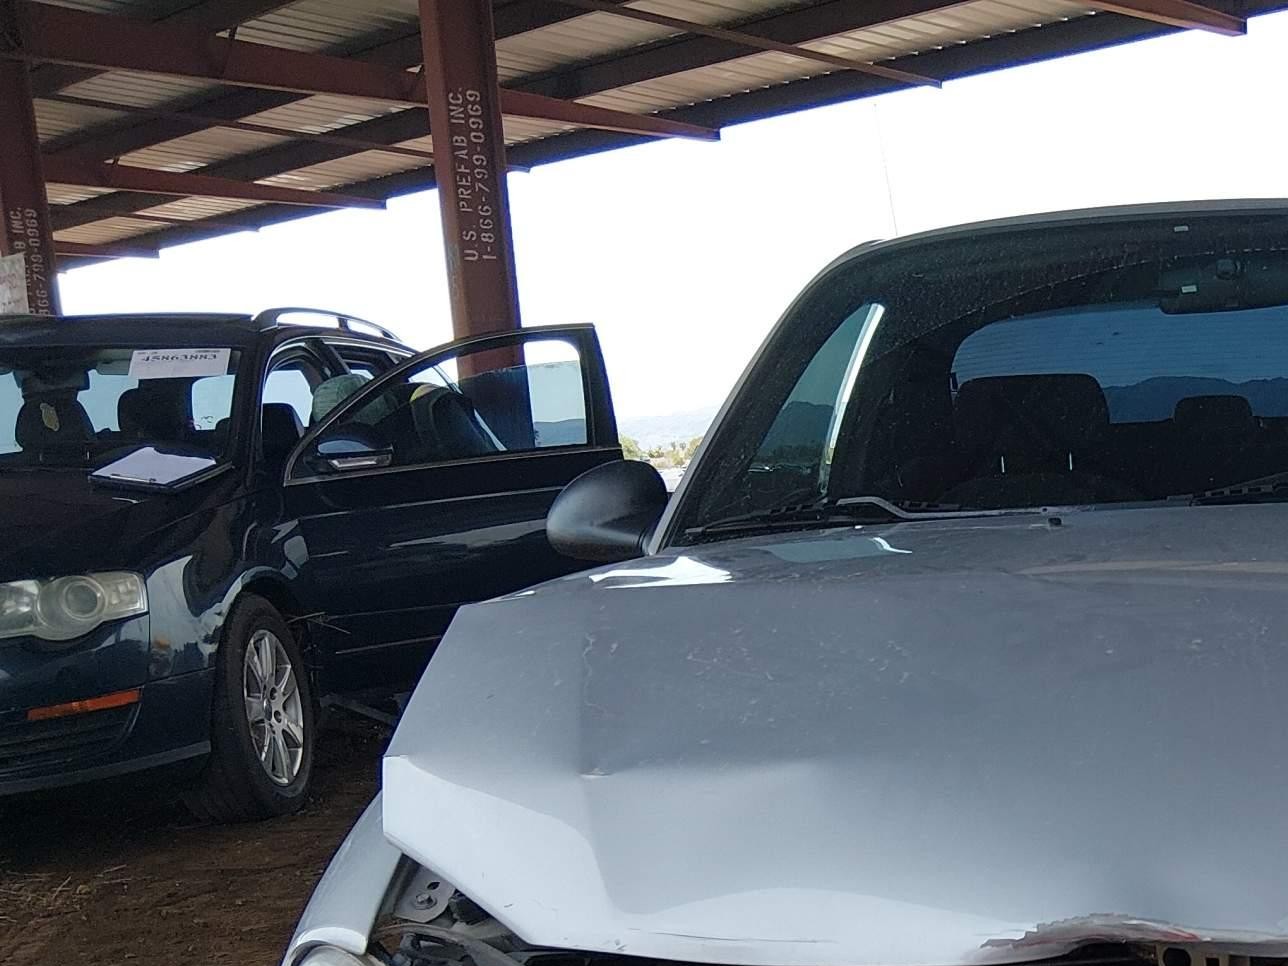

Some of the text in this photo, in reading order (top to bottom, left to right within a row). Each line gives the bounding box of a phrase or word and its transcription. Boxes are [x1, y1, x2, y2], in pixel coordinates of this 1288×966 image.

[449, 87, 479, 261] U.S. PREFAB INC.
[466, 90, 497, 261] 1-866-799-0969
